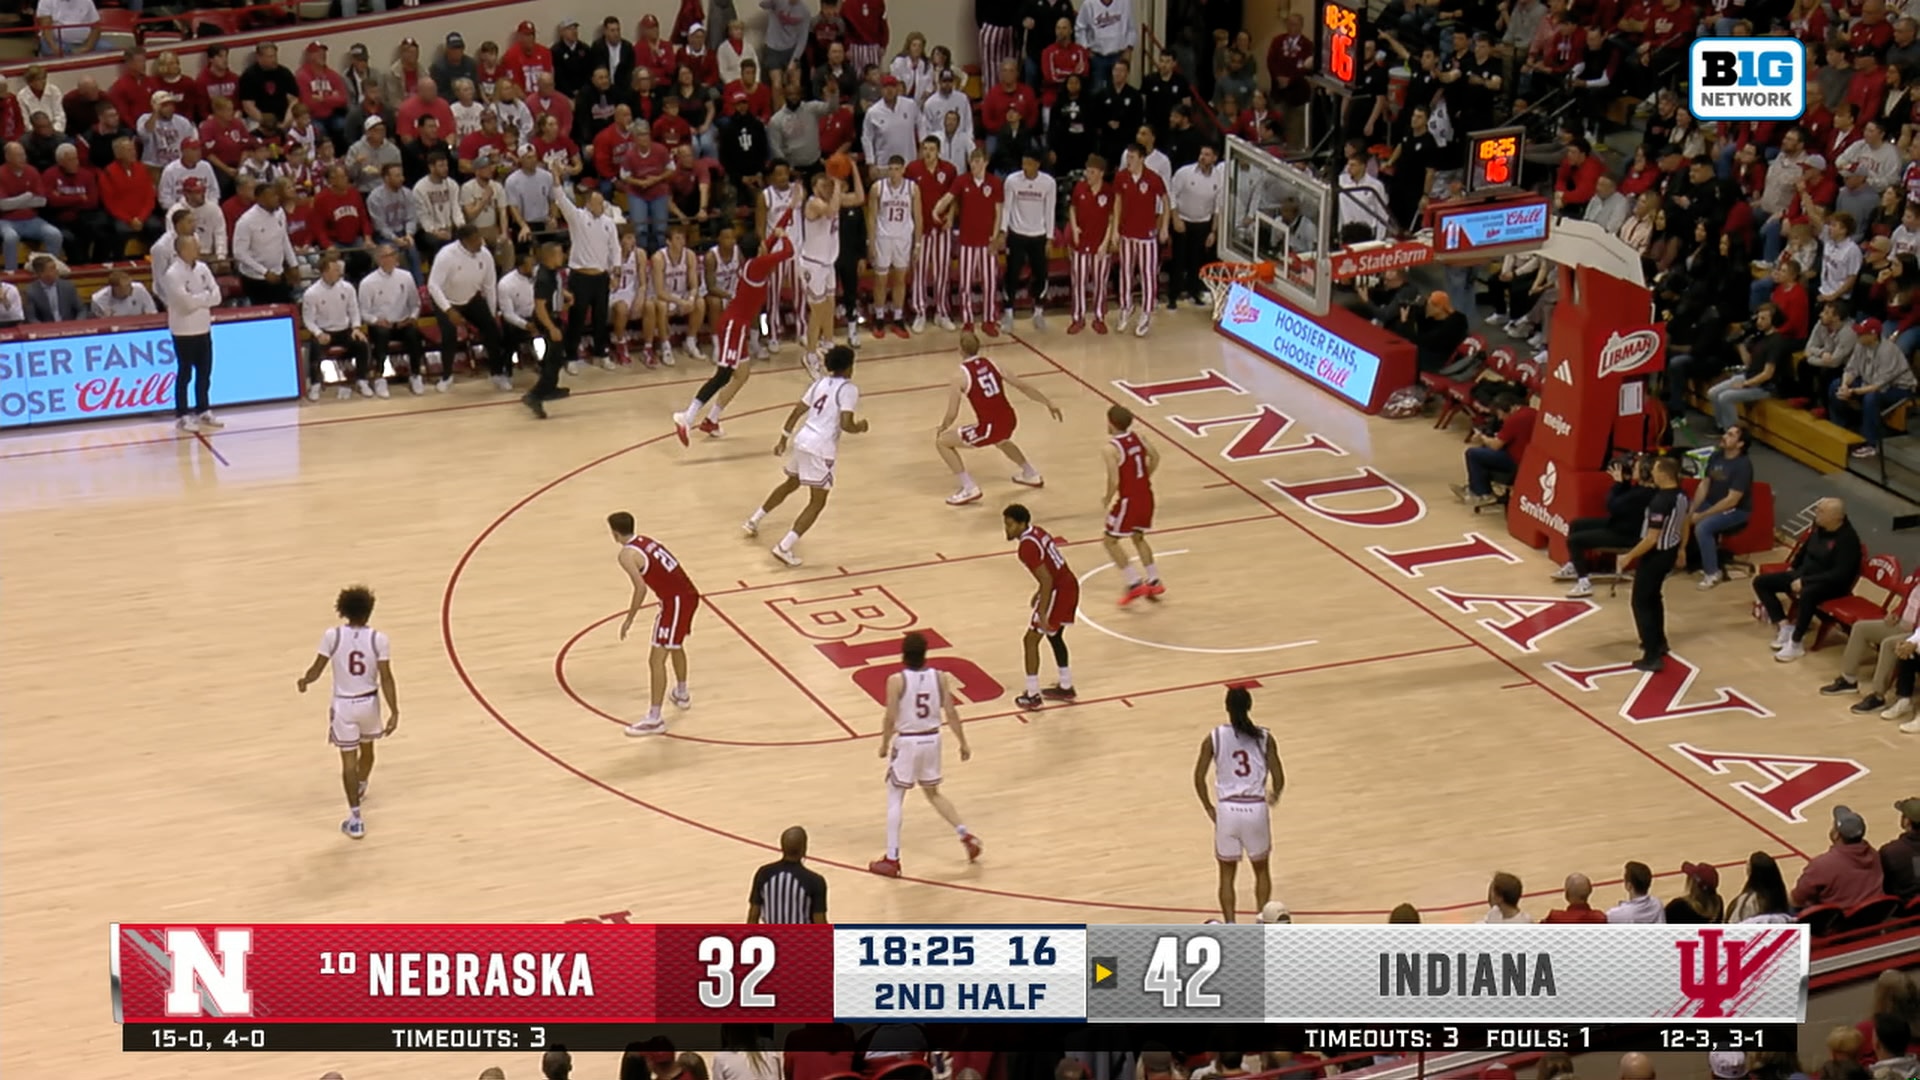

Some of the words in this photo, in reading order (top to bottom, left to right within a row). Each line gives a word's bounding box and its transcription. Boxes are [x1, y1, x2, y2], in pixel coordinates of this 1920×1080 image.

[1325, 4, 1357, 38] 18:25
[1331, 33, 1354, 82] 16
[1480, 137, 1516, 160] 18:25
[1486, 156, 1509, 183] 16
[889, 207, 904, 221] 13
[1506, 207, 1544, 226] Chill
[1275, 311, 1327, 352] HOOSIER
[1326, 339, 1358, 372] FANS,
[1602, 337, 1652, 371] LIBMAN
[1273, 335, 1317, 370] CHOOSE
[1316, 357, 1352, 389] Chill
[75, 372, 177, 412] Chill
[977, 372, 1000, 398] 51
[813, 394, 829, 415] 4
[1543, 411, 1572, 436] meijer
[1134, 455, 1144, 479] 1
[1519, 495, 1570, 537] Smithville
[1111, 368, 1870, 825] INDIANA
[348, 651, 366, 676] 6
[916, 693, 930, 719] 5
[1232, 750, 1251, 777] 3
